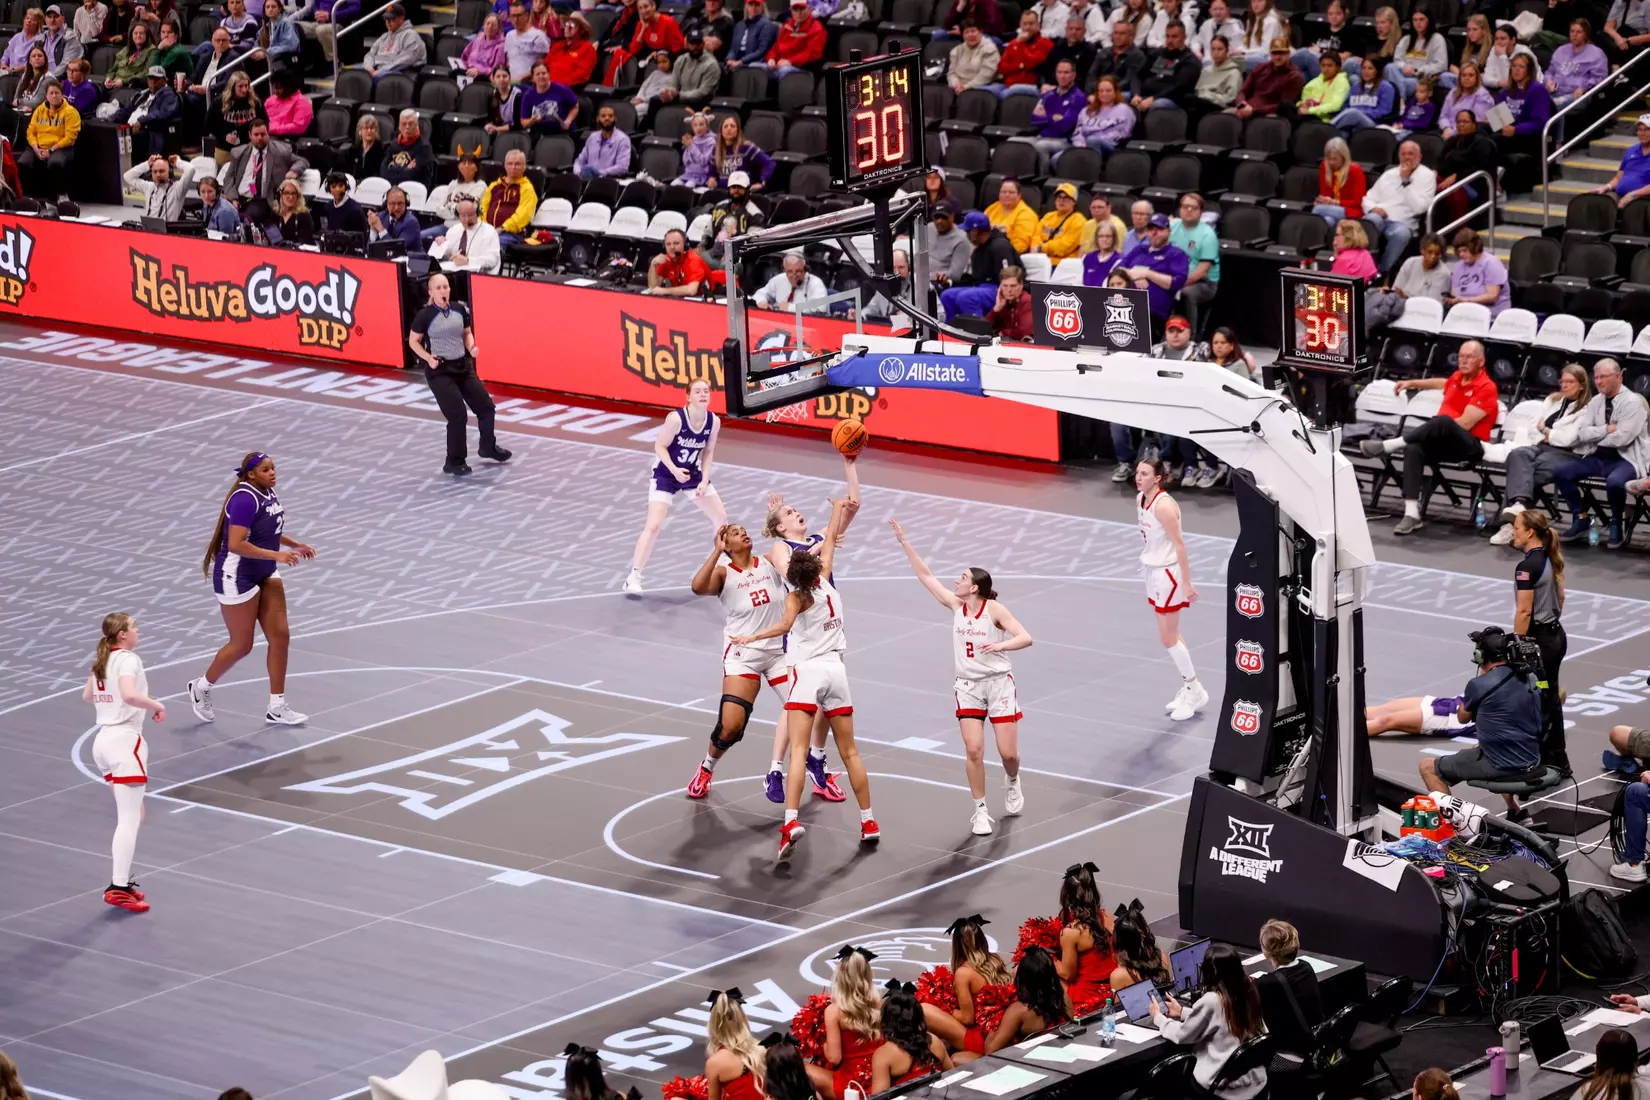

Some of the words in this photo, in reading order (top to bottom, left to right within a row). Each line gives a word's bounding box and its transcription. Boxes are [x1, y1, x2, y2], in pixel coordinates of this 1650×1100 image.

[862, 68, 908, 106] 3:14
[856, 104, 904, 169] 30
[864, 165, 903, 180] DAKTRONICS
[132, 254, 247, 320] Heluva
[247, 265, 359, 325] Good!
[1049, 298, 1077, 309] PHILLIPS
[1307, 286, 1348, 314] 3:14
[1053, 312, 1075, 329] 66
[298, 317, 349, 348] DIP
[1306, 315, 1340, 349] 30
[624, 318, 725, 388] Heluv
[1295, 350, 1345, 362] DAKTRONICS
[905, 362, 966, 382] Allstate
[815, 392, 871, 421] DIP
[677, 448, 700, 465] 34
[749, 588, 771, 608] 23
[1239, 587, 1260, 597] PHILLIPS
[827, 594, 835, 618] 1
[1240, 597, 1258, 612] 66
[965, 641, 975, 658] 2
[1239, 643, 1260, 654] PHILLIPS
[1240, 653, 1258, 668] 66
[1237, 704, 1258, 715] PHILLIPS
[1236, 714, 1255, 729] 66
[1273, 712, 1306, 728] DAKTRONICS
[1209, 846, 1219, 861] A
[1218, 849, 1284, 873] DIFFERENT
[1221, 862, 1267, 884] LEAGUE
